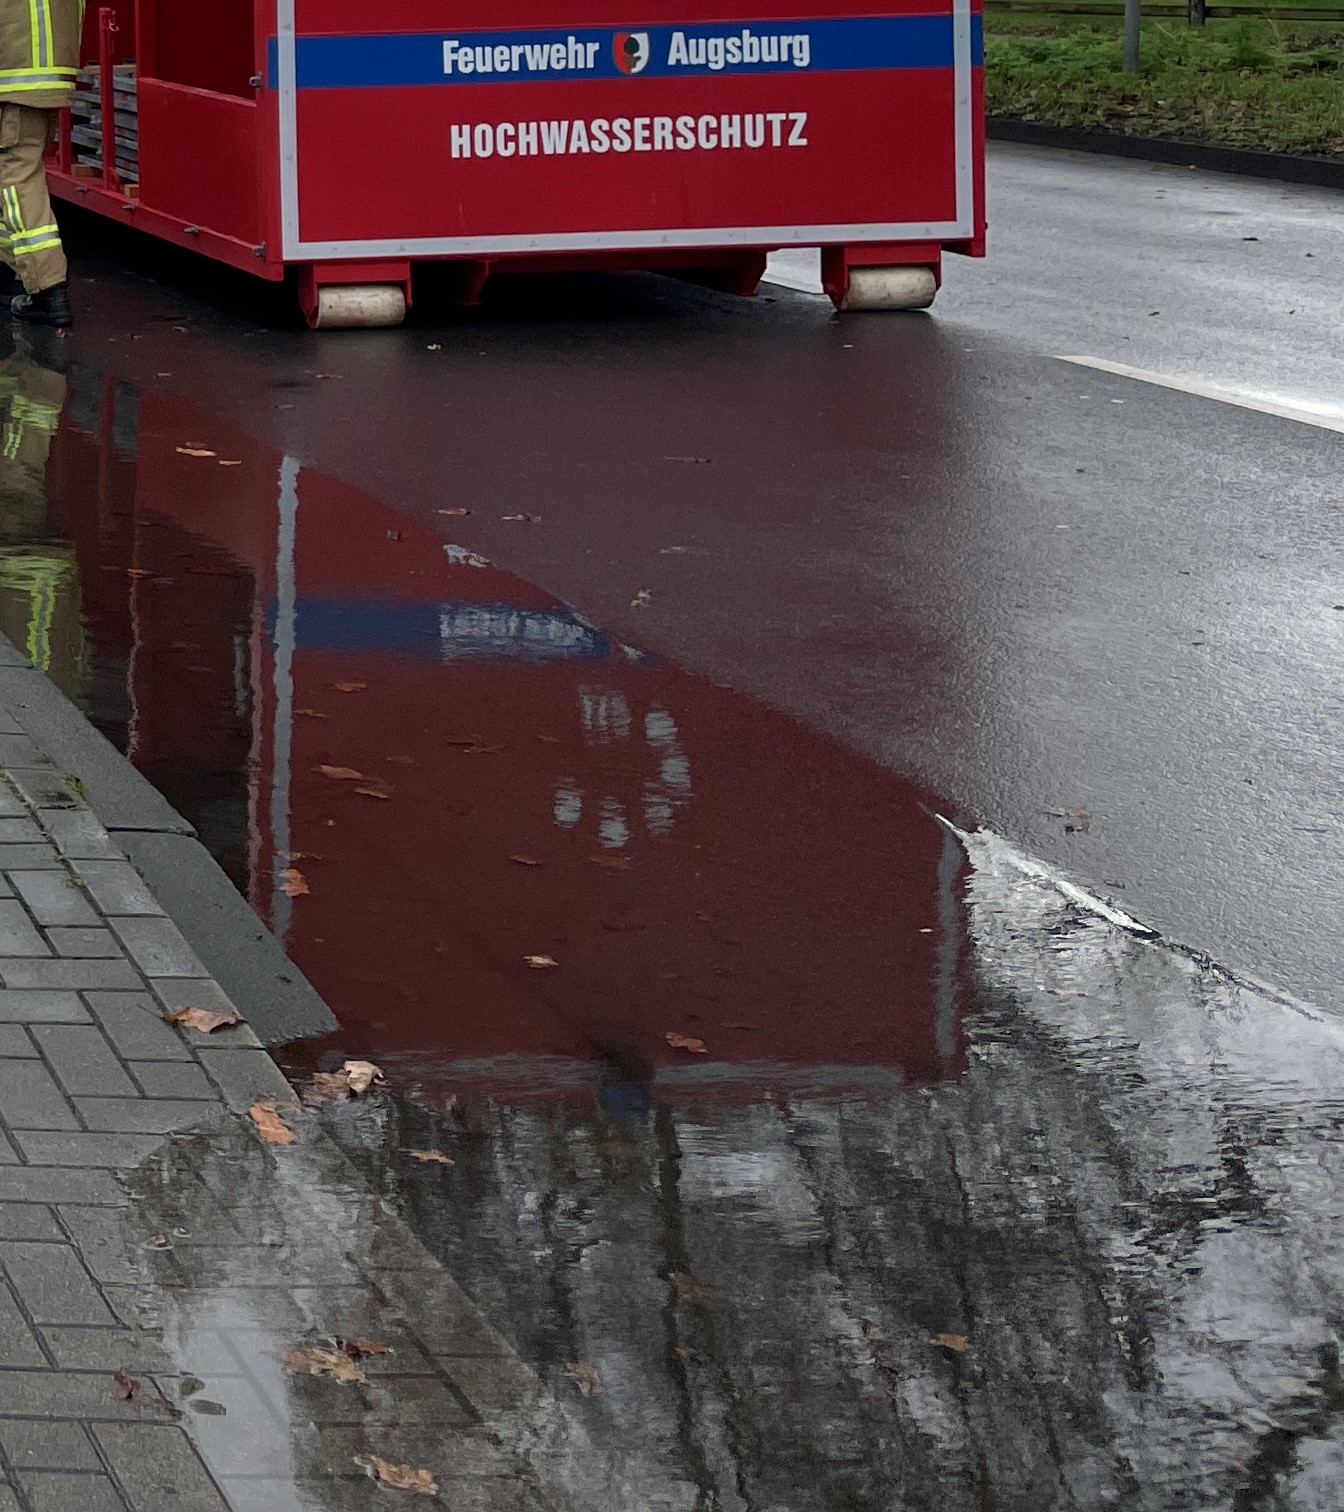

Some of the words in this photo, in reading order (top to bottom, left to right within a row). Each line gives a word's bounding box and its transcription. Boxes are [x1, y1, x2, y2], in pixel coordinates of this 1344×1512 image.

[443, 36, 600, 74] Feuerwehr
[667, 30, 810, 70] Augsburg
[450, 112, 808, 159] HOCHWASSERSCHUTZ
